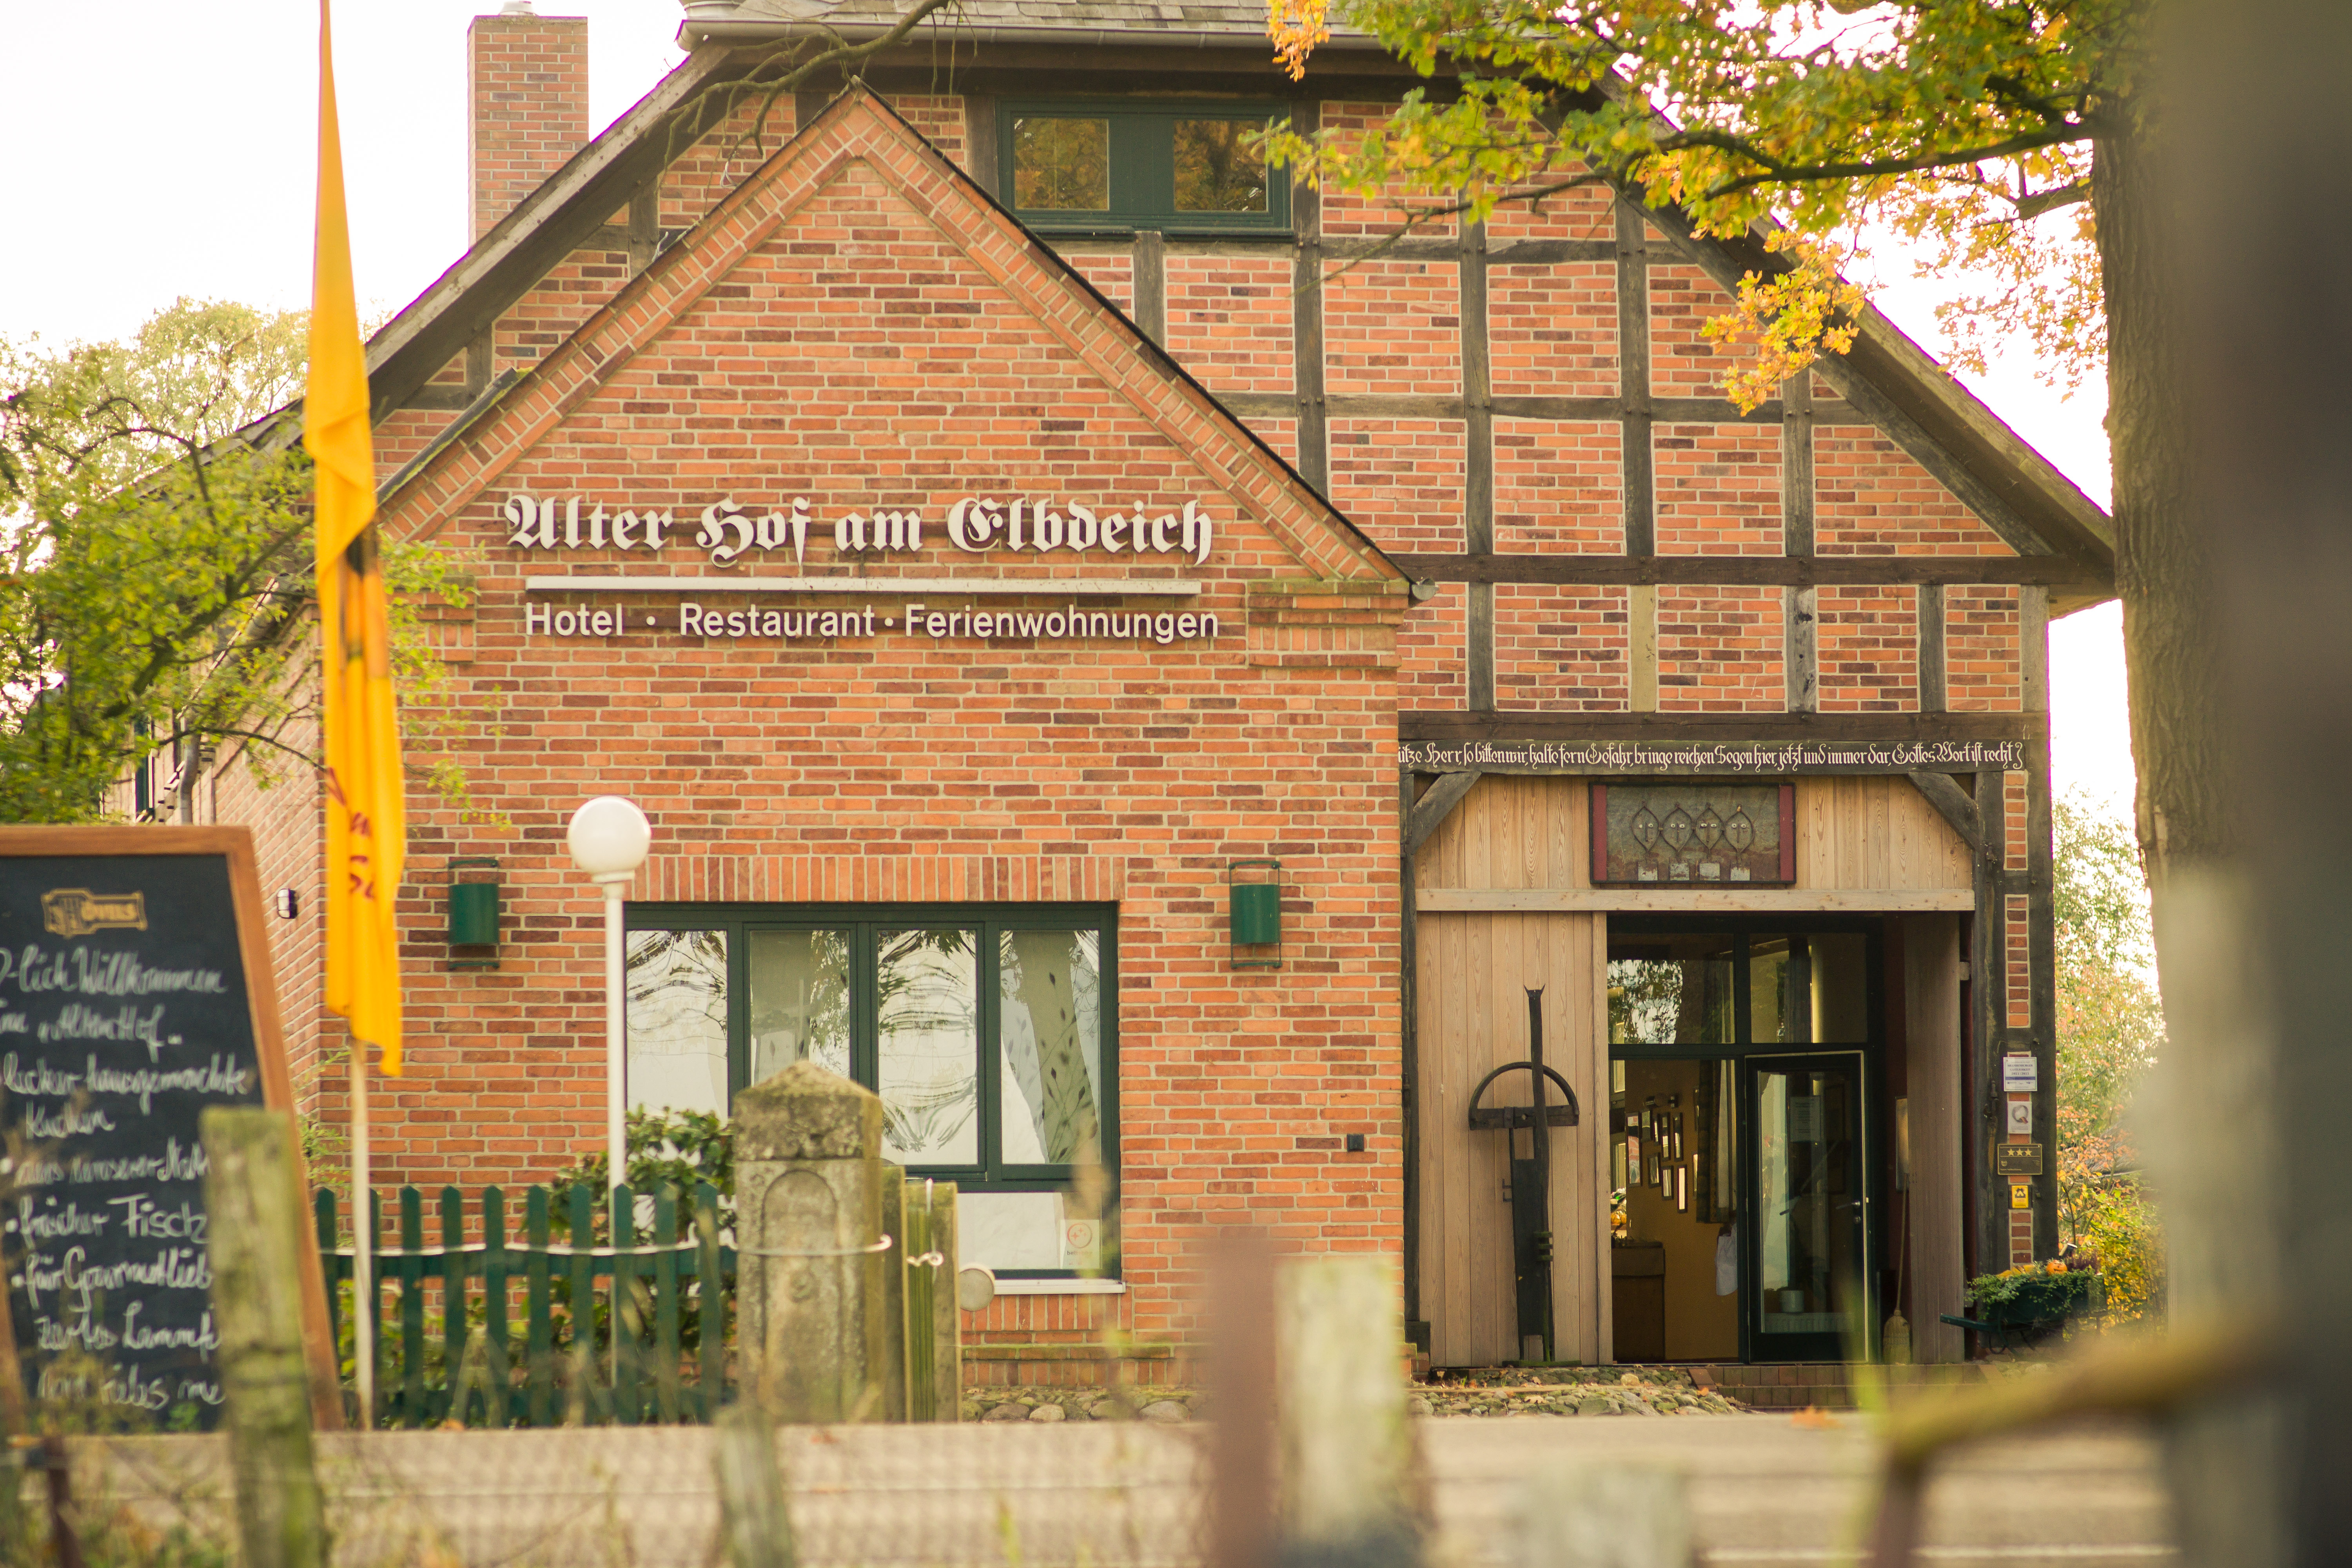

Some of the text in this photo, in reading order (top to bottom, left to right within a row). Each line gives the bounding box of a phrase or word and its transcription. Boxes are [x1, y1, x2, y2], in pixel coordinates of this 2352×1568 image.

[504, 494, 1213, 568] Alter Hof am Elbdeich
[526, 602, 1218, 644] Hotel Restaurant Ferienwohnungen
[1633, 742, 1673, 771] bringe
[1674, 743, 1715, 773] reichen
[1714, 744, 1753, 771] Segen
[1804, 744, 1826, 764] und
[1891, 742, 1935, 765] Gottes
[1984, 740, 2014, 769] recht
[106, 1192, 212, 1244] Fisch
